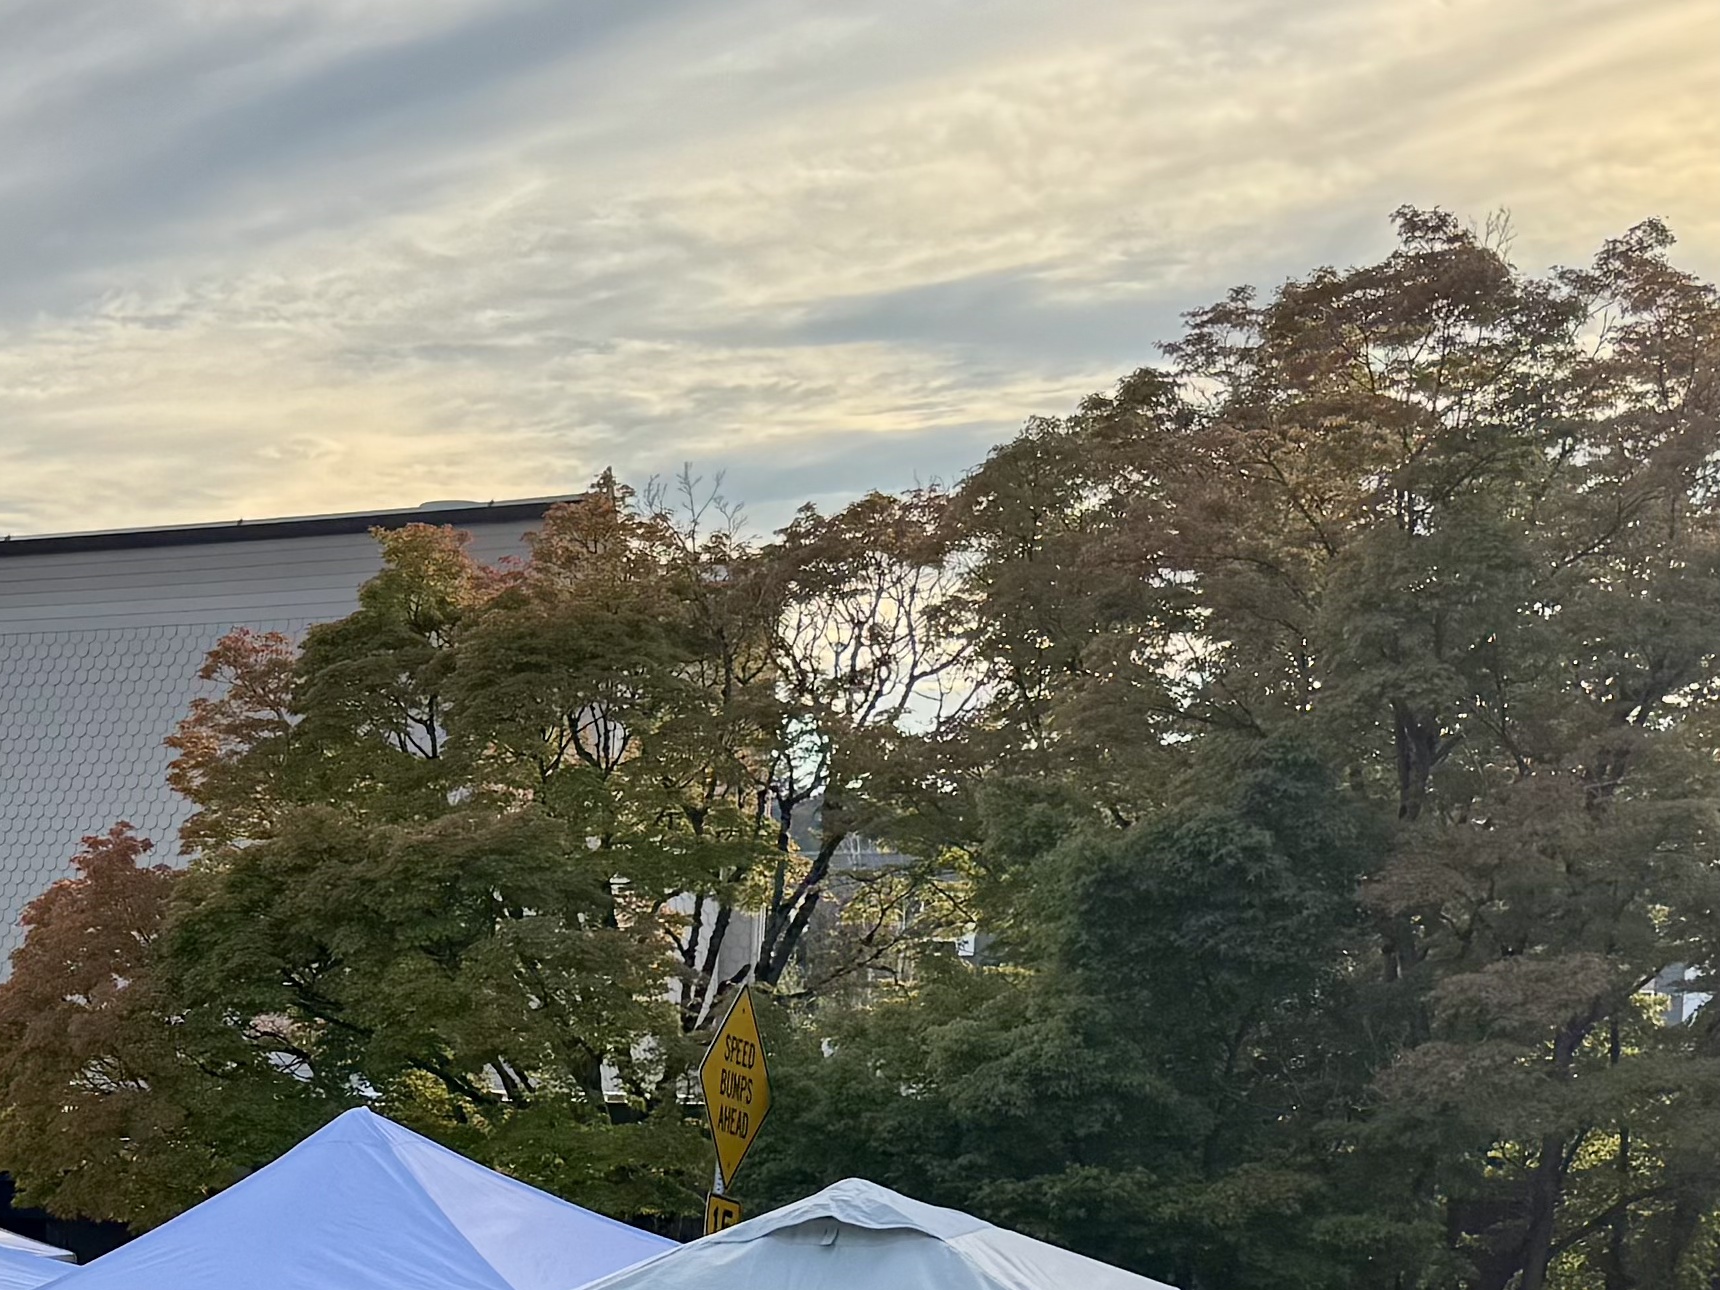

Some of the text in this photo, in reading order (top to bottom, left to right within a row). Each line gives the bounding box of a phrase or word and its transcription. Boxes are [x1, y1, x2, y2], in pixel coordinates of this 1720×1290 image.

[724, 1033, 756, 1070] SPEED
[719, 1068, 754, 1105] BUMPS
[717, 1103, 749, 1139] AHEAD
